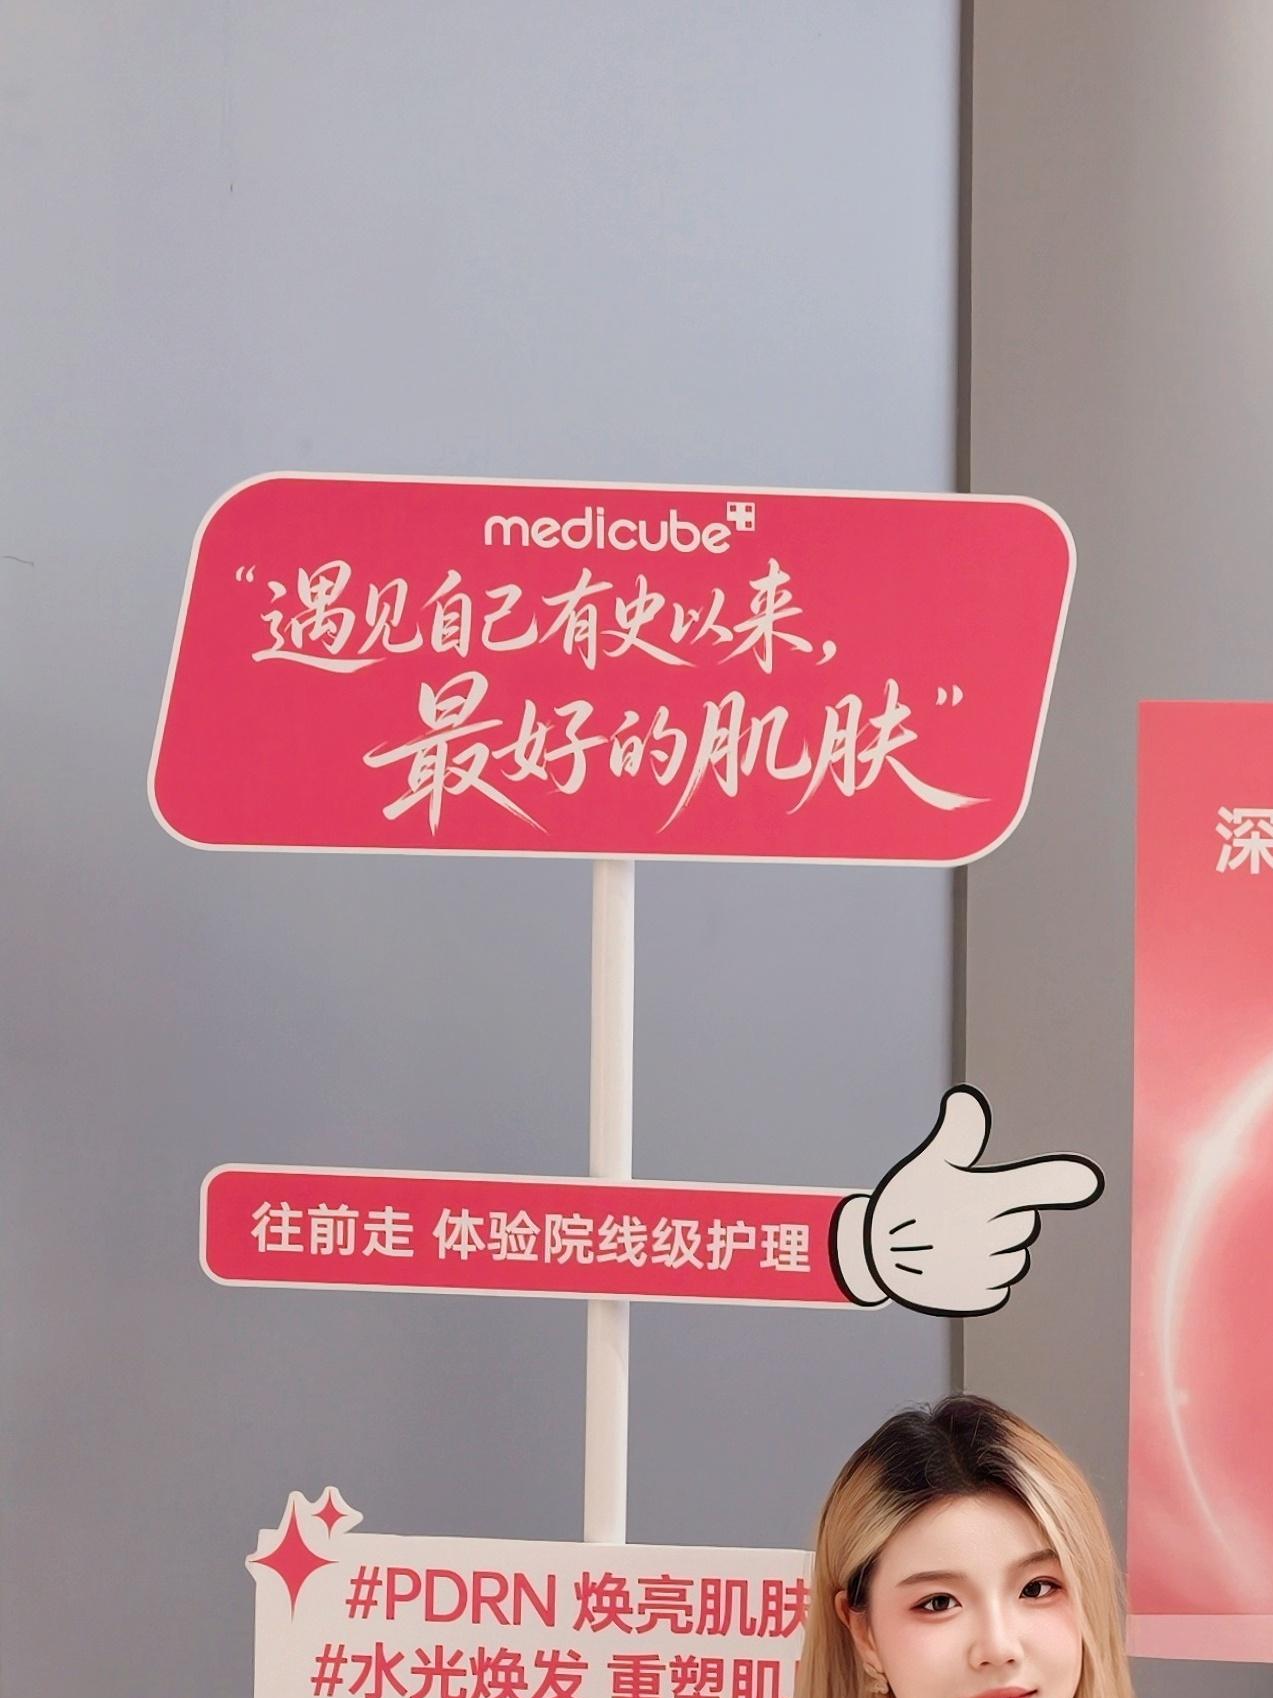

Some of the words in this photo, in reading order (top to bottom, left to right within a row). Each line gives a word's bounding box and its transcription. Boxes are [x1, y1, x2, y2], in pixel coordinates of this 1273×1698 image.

[484, 505, 735, 554] medicube
[250, 1201, 415, 1259] 往前走
[432, 1207, 812, 1275] 体验院线级护理
[345, 1566, 556, 1629] #PDRN
[573, 1573, 811, 1639] 焕亮肌肤
